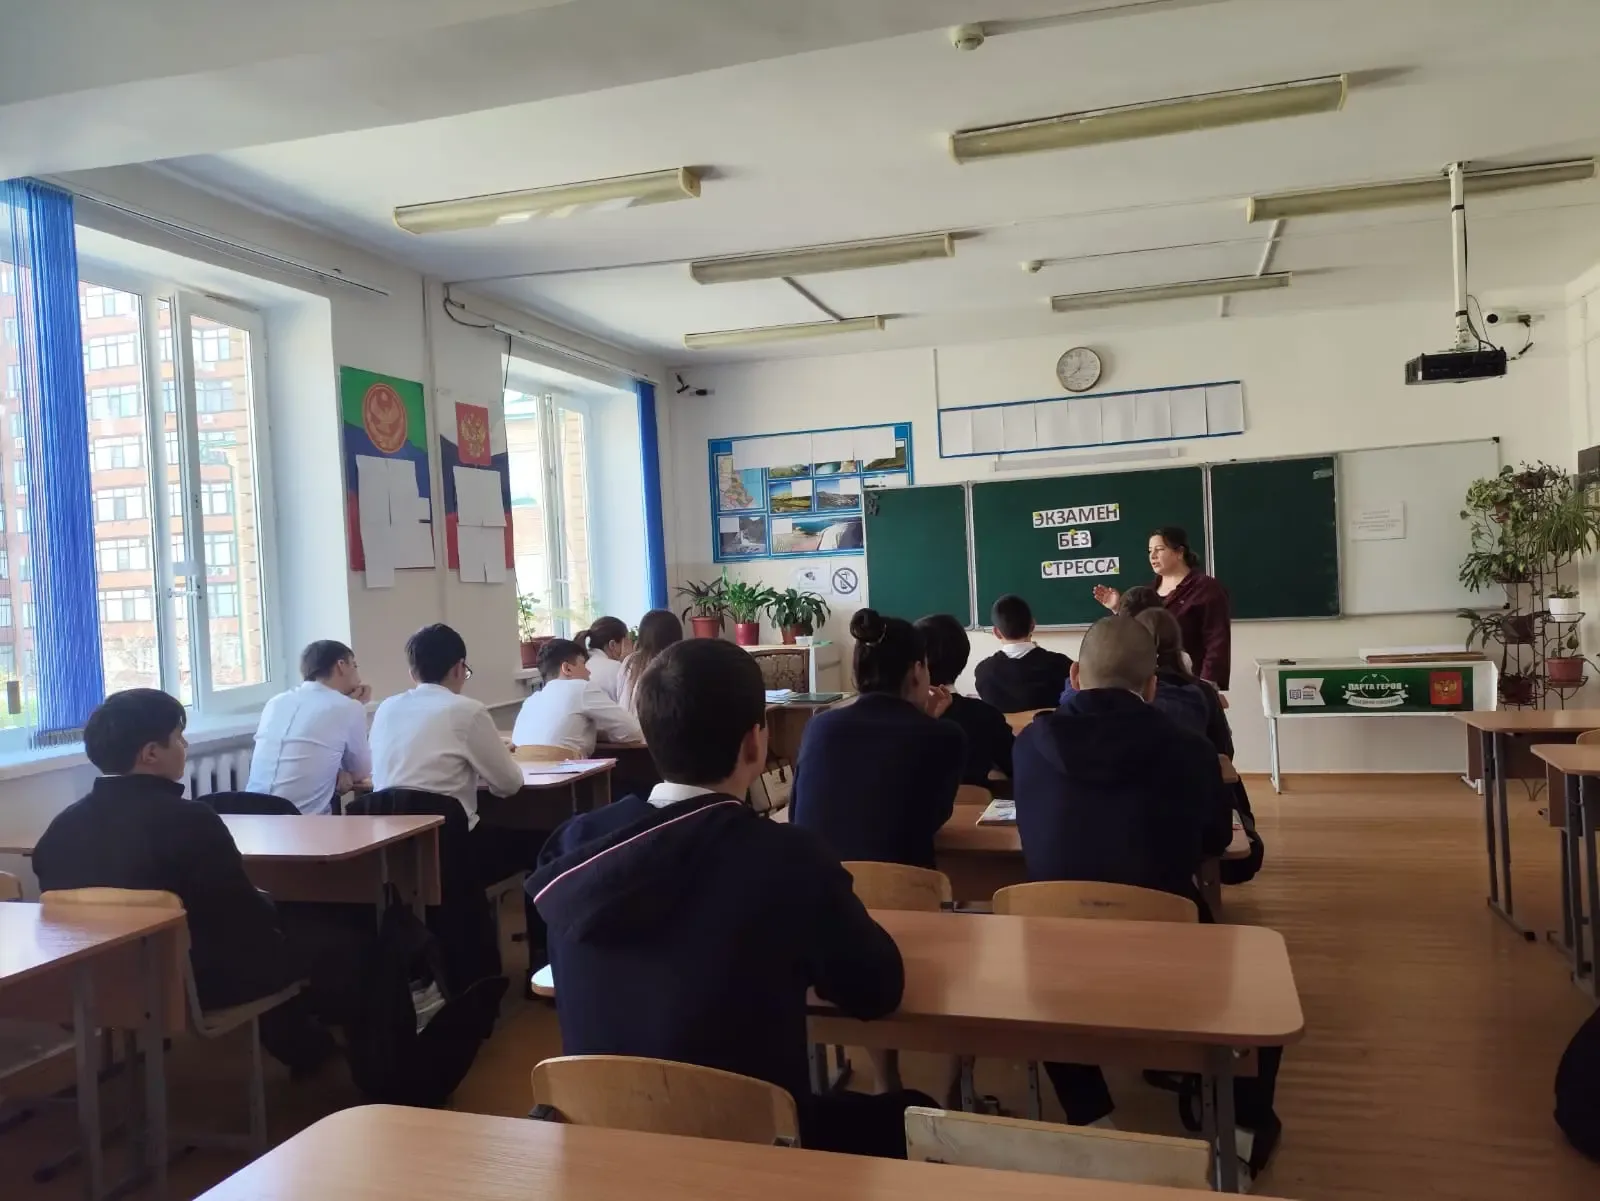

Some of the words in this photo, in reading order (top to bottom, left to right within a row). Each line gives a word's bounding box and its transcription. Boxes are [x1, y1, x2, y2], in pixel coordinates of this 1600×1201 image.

[1034, 505, 1118, 527] ЭКЗАМЕН
[1059, 531, 1090, 548] БЕЗ
[1042, 558, 1118, 577] СТРЕССА
[1348, 683, 1375, 691] ПАРТА
